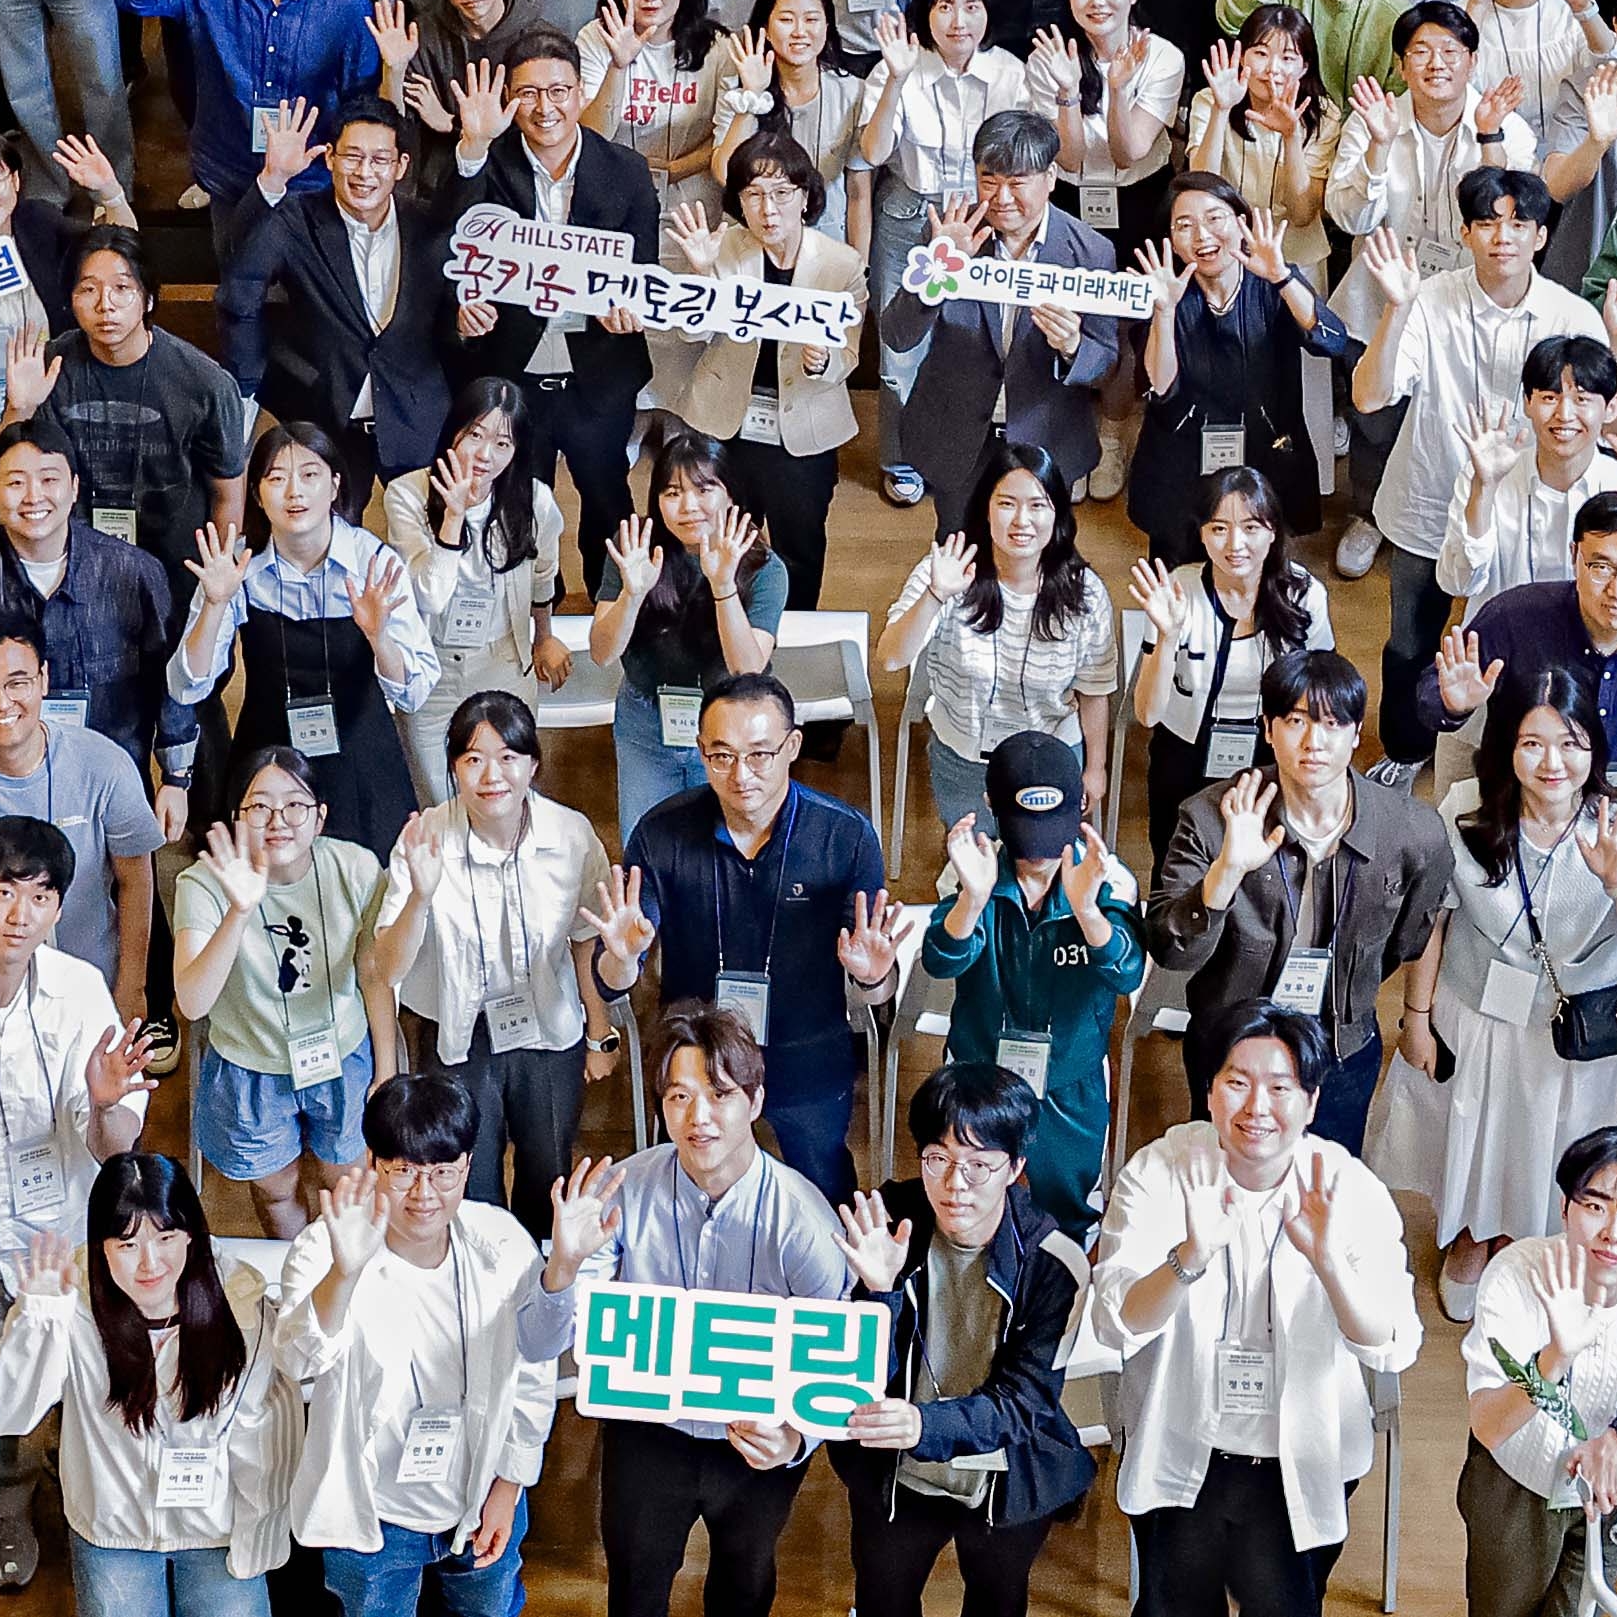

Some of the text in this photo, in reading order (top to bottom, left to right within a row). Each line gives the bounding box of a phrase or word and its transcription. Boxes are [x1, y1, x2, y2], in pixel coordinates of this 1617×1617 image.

[630, 78, 698, 105] Field
[623, 104, 656, 126] ay
[511, 224, 627, 260] HILLSTATE
[451, 242, 856, 342] 꿈키움 멘토링 봉사단
[969, 264, 1154, 313] 아이들과미래재단
[1054, 943, 1089, 966] 031
[585, 1292, 879, 1428] 멘토링
